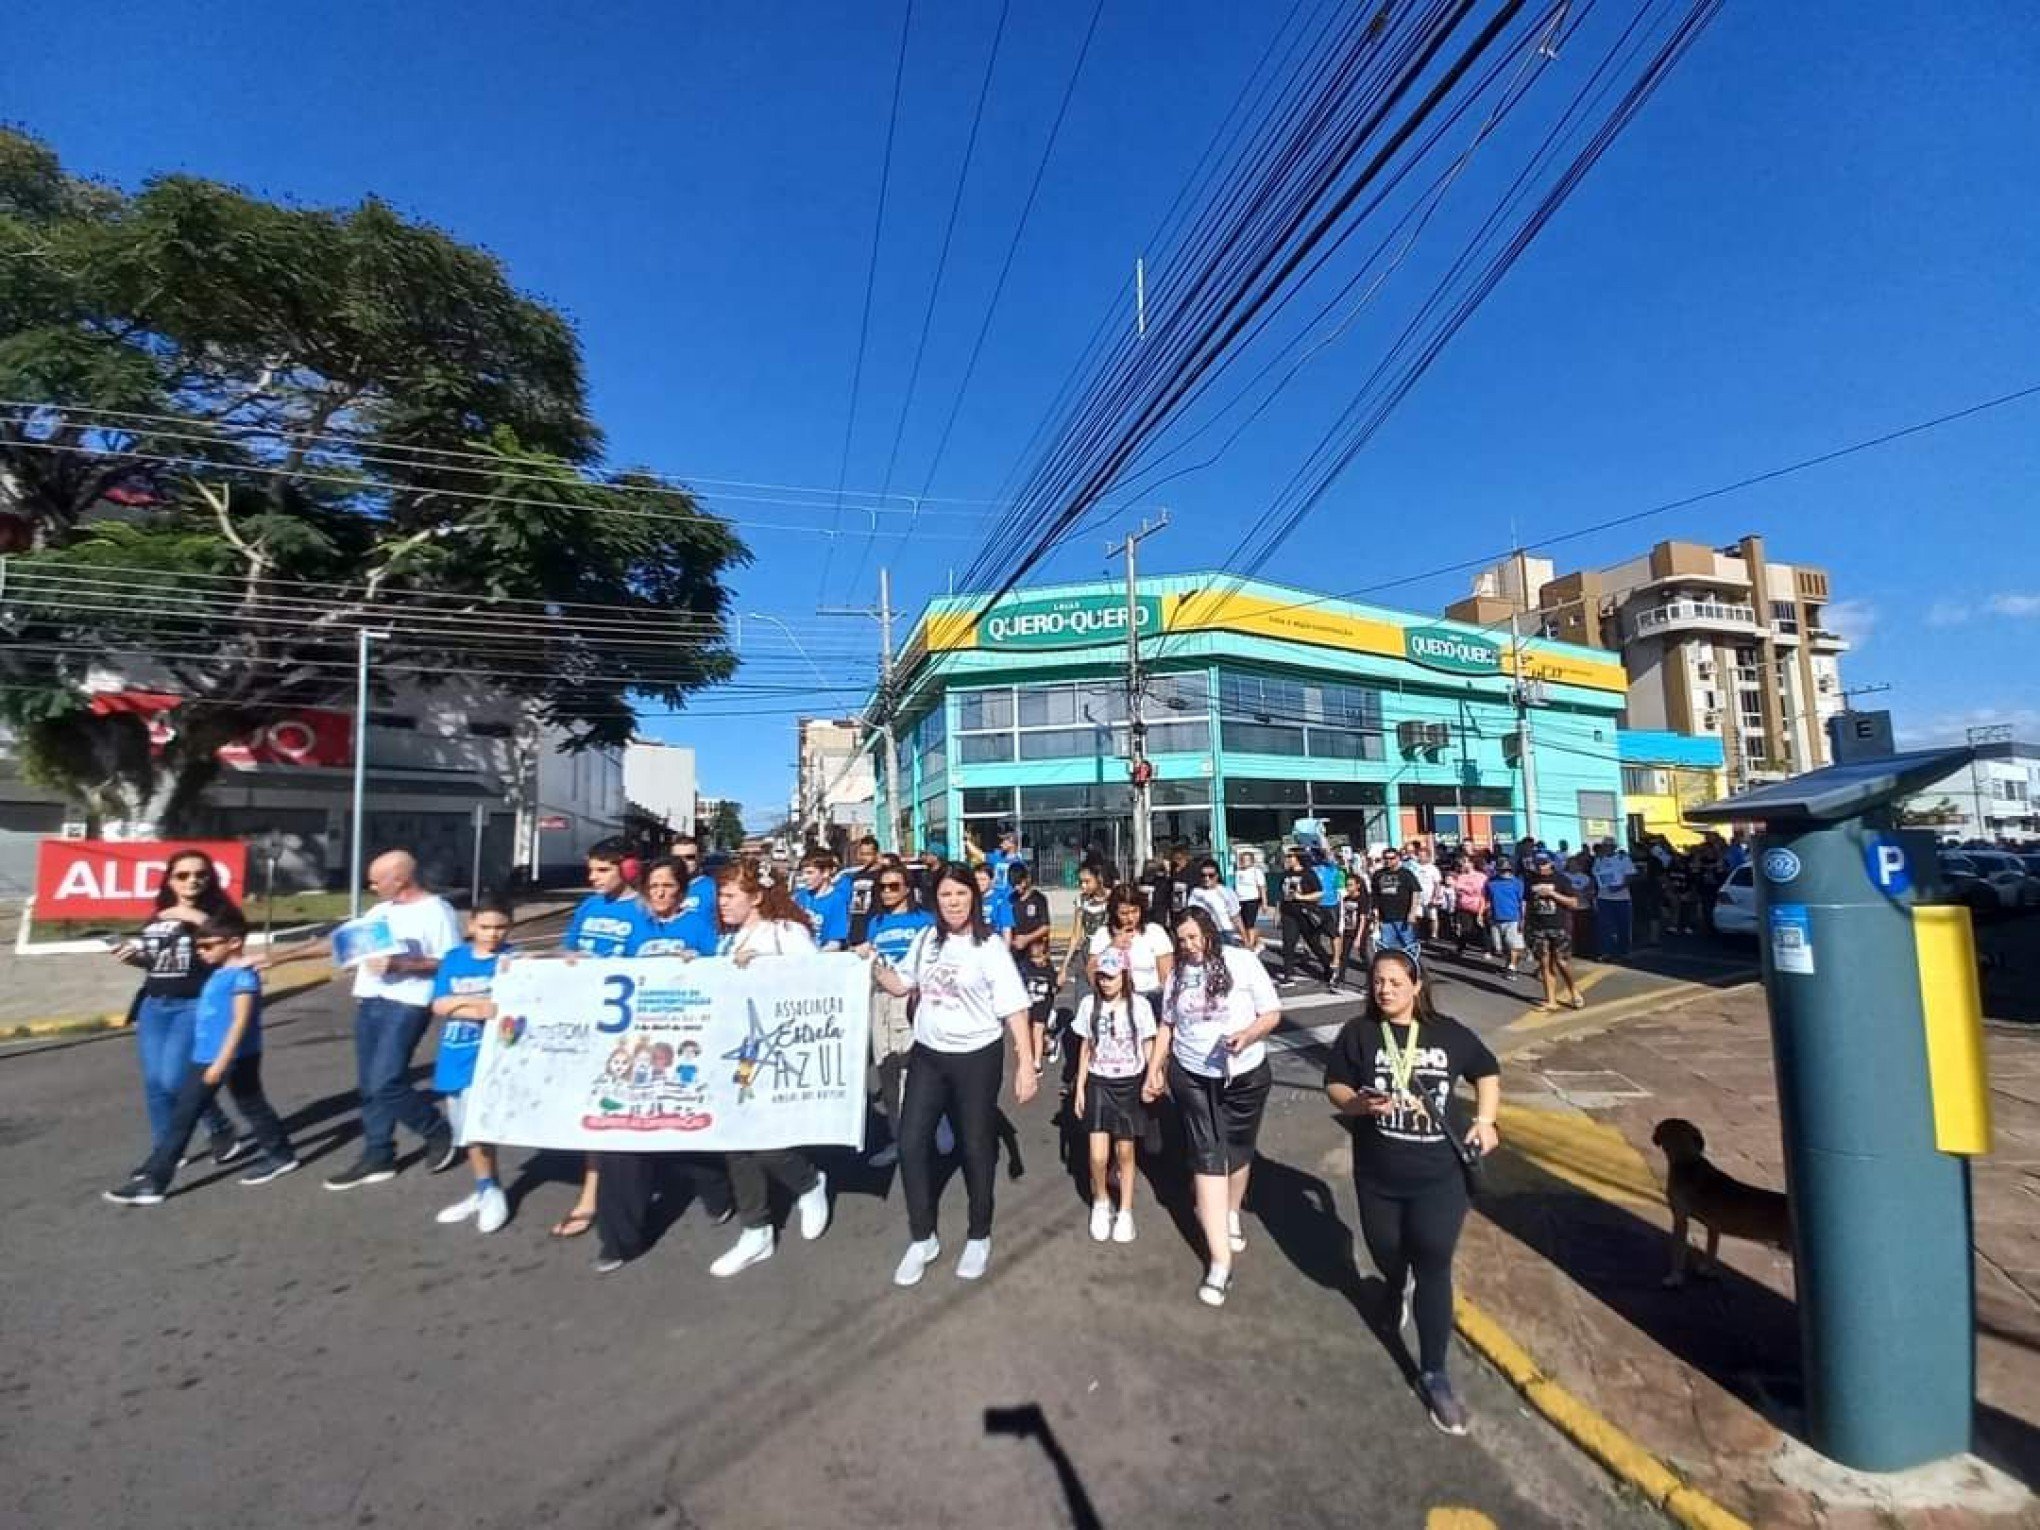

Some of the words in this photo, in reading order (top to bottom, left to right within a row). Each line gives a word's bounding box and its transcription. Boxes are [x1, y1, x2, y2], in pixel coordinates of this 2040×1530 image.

[988, 605, 1149, 641] QUERO-QUERO
[1878, 845, 1904, 885] P
[774, 1042, 846, 1089] AZUL
